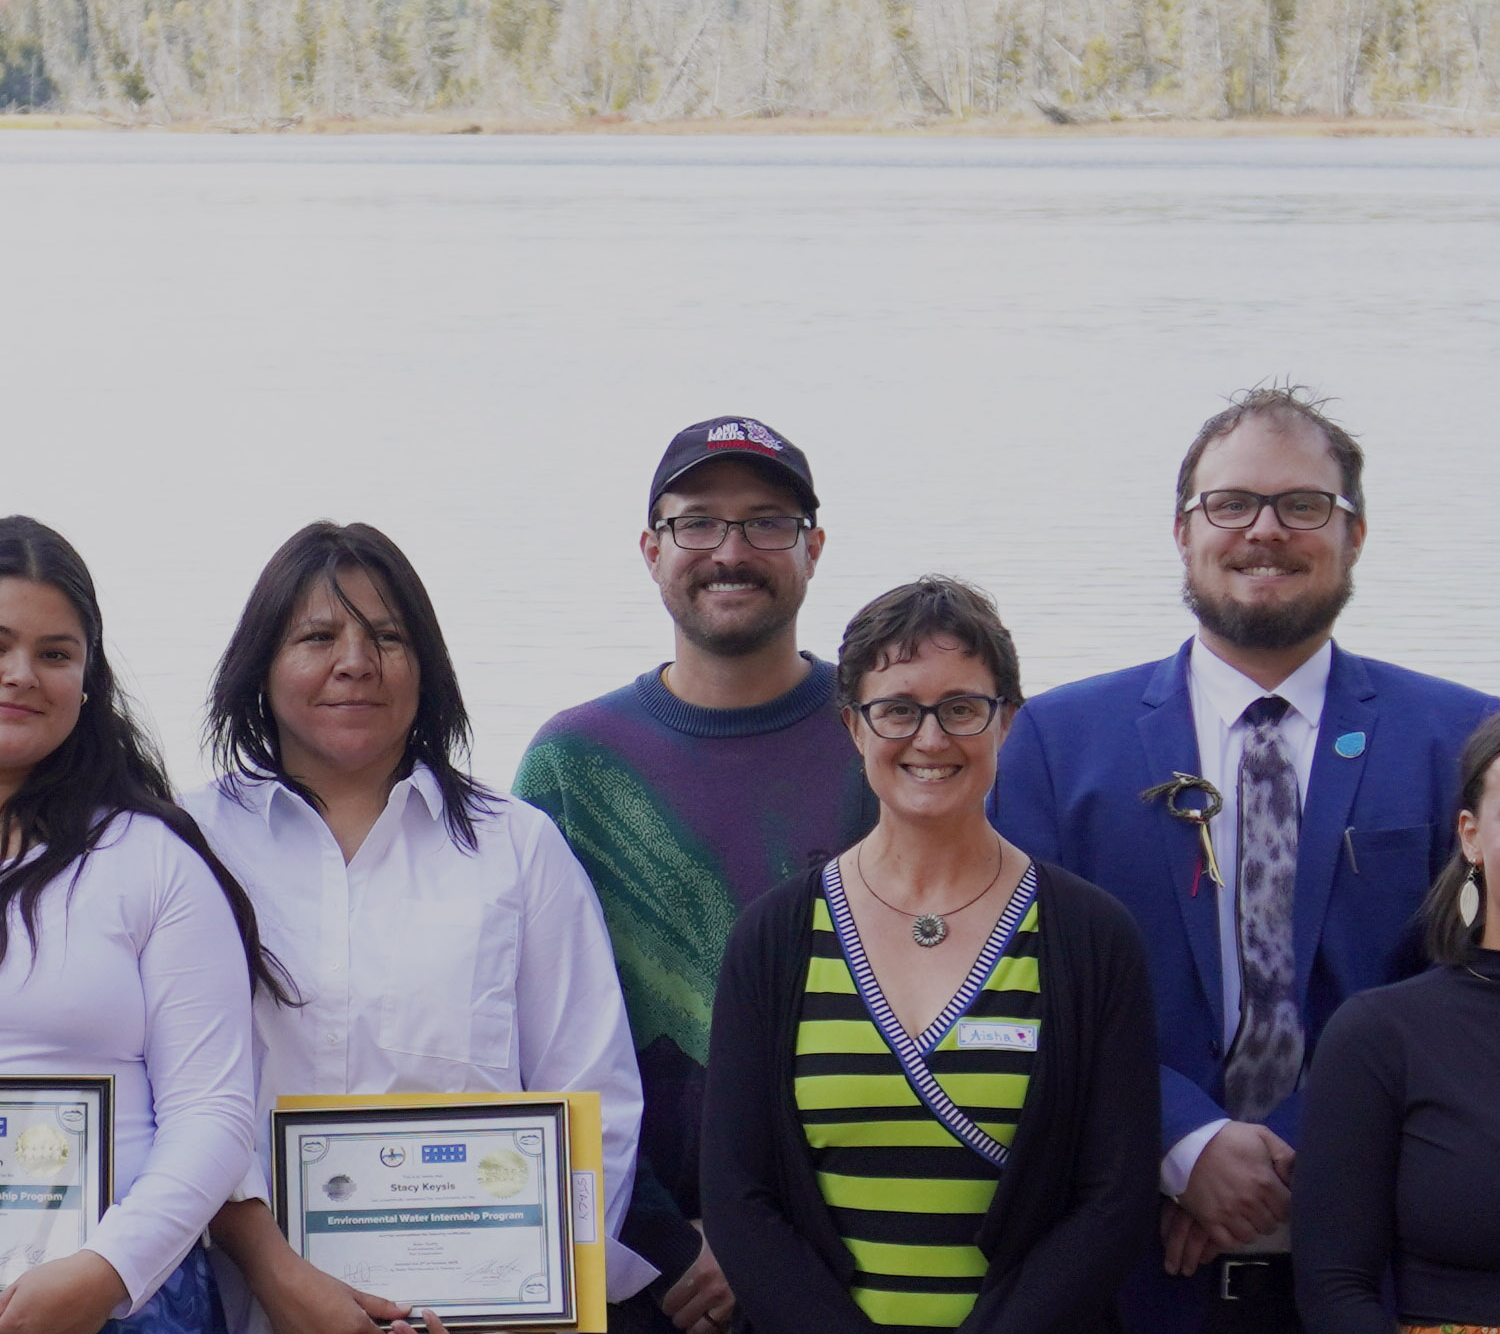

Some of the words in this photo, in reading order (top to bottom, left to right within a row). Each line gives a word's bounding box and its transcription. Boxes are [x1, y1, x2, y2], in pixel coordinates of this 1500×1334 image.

[708, 422, 739, 435] LAND
[969, 1028, 1014, 1043] Aisha
[390, 1183, 419, 1194] Stacy
[422, 1181, 456, 1192] Keysis
[20, 1191, 63, 1202] Program
[577, 1177, 591, 1221] STACY
[327, 1215, 398, 1226] Environmental
[399, 1214, 429, 1223] Water
[430, 1212, 481, 1223] Internship
[482, 1211, 524, 1221] Program
